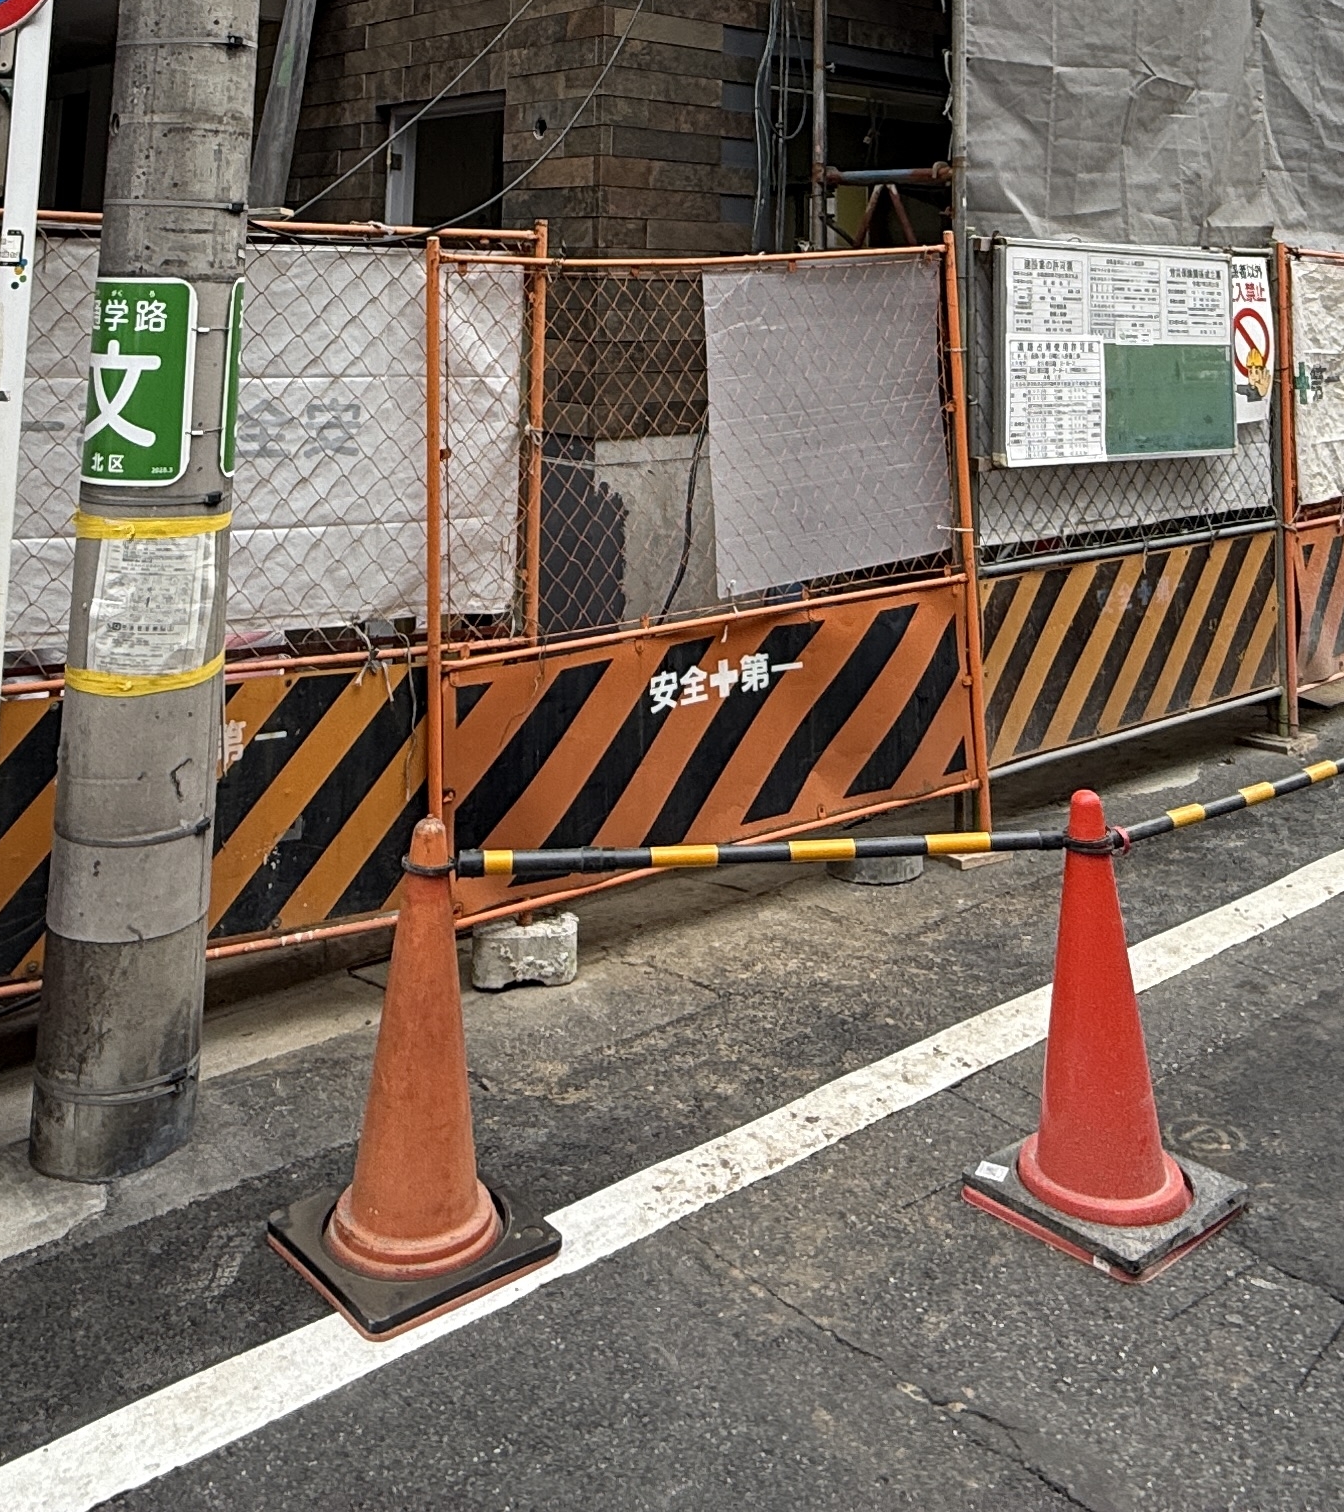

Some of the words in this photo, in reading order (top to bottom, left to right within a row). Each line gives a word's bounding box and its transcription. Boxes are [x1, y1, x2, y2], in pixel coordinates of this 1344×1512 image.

[1232, 282, 1268, 304] 入禁止
[91, 452, 124, 473] 北区
